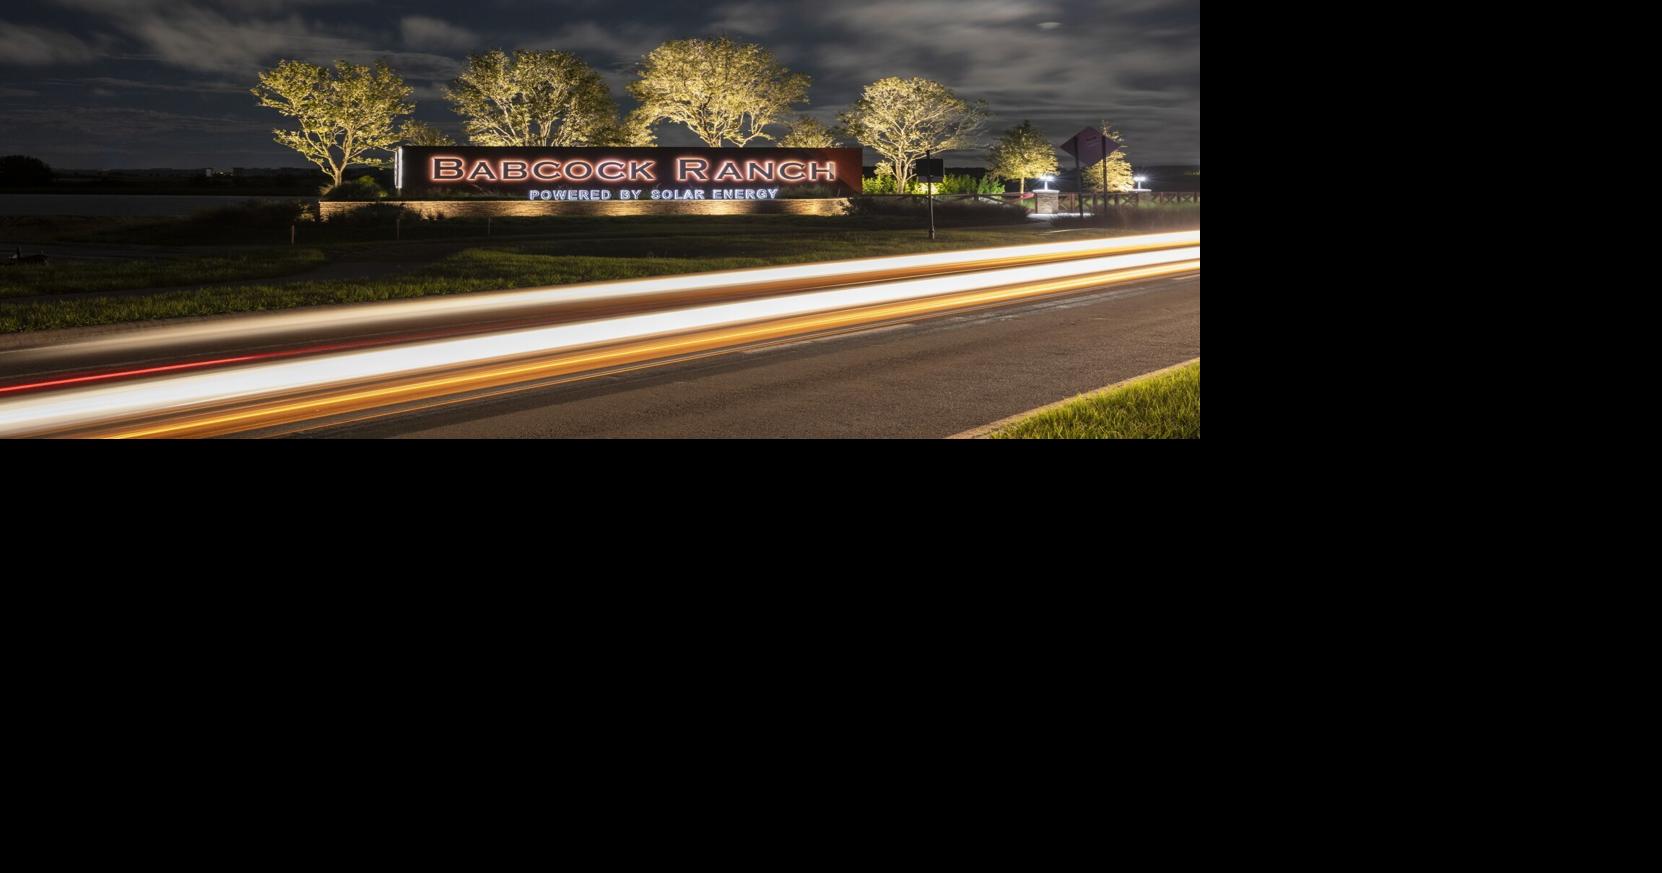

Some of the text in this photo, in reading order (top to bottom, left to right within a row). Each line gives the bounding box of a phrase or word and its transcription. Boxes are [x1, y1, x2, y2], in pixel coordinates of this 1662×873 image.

[431, 156, 836, 181] BABCOCK RANCH
[529, 188, 778, 200] POWERED BY SOLAR ENERGY
